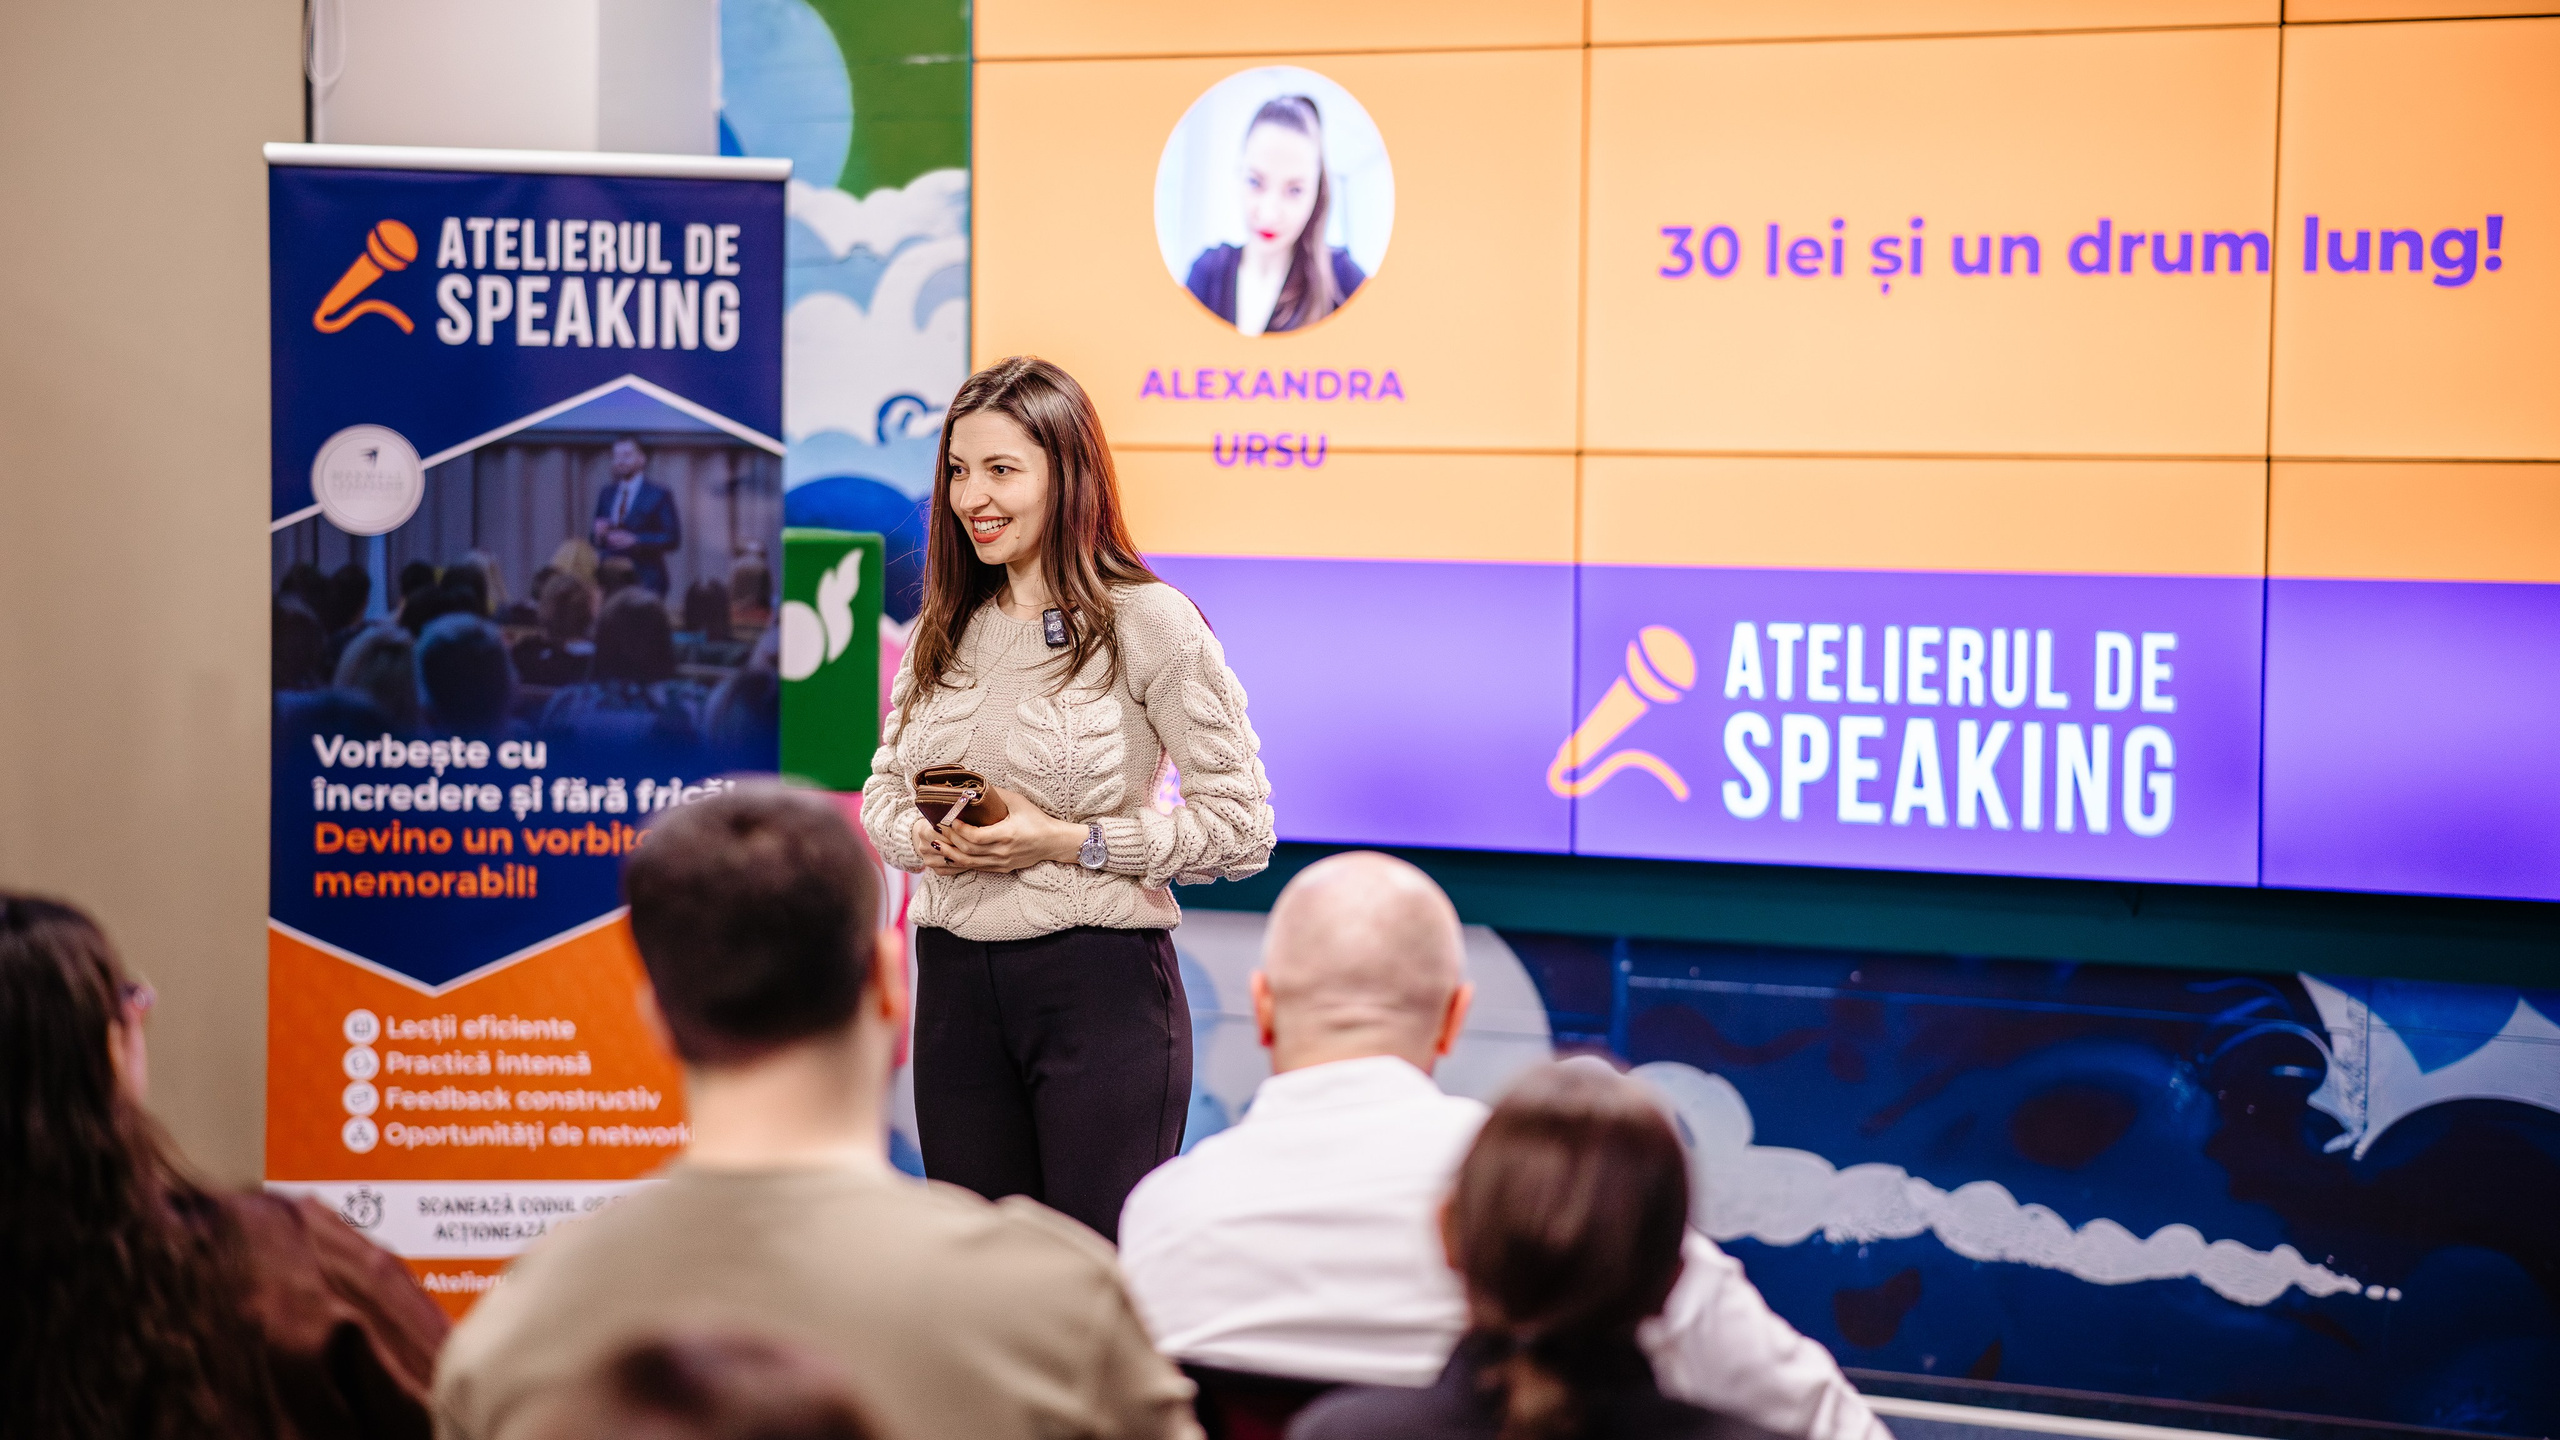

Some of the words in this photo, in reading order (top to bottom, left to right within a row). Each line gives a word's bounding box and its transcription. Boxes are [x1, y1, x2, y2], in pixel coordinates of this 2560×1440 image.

[436, 216, 672, 274] ATELIERUL
[684, 222, 741, 277] DE
[1658, 222, 1741, 280] 30
[1765, 216, 1846, 279] lei
[1869, 216, 1925, 296] și
[1950, 230, 2041, 277] un
[2066, 217, 2271, 277] drum
[2302, 214, 2505, 289] lung!
[435, 273, 741, 352] SPEAKING
[1140, 367, 1406, 401] ALEXANDRA
[1212, 432, 1328, 469] URSU
[1722, 620, 2071, 711] ATELIERUL
[2093, 630, 2179, 713] DE
[311, 733, 491, 777] Vorbește
[497, 738, 548, 769] cu
[1721, 710, 2178, 838] SPEAKING
[311, 775, 503, 812] încredere
[509, 776, 543, 821] și
[550, 776, 628, 814] fără
[314, 820, 453, 855] Devino
[463, 827, 514, 855] un
[313, 863, 539, 899] memorabil!
[386, 1013, 457, 1045] Lecții
[461, 1014, 577, 1042] eficiente
[385, 1048, 491, 1076] Practică
[497, 1049, 592, 1077] intensă
[384, 1084, 512, 1112] Feedback
[515, 1085, 662, 1112] constructiv
[383, 1119, 544, 1151] Oportunități
[548, 1120, 584, 1147] de
